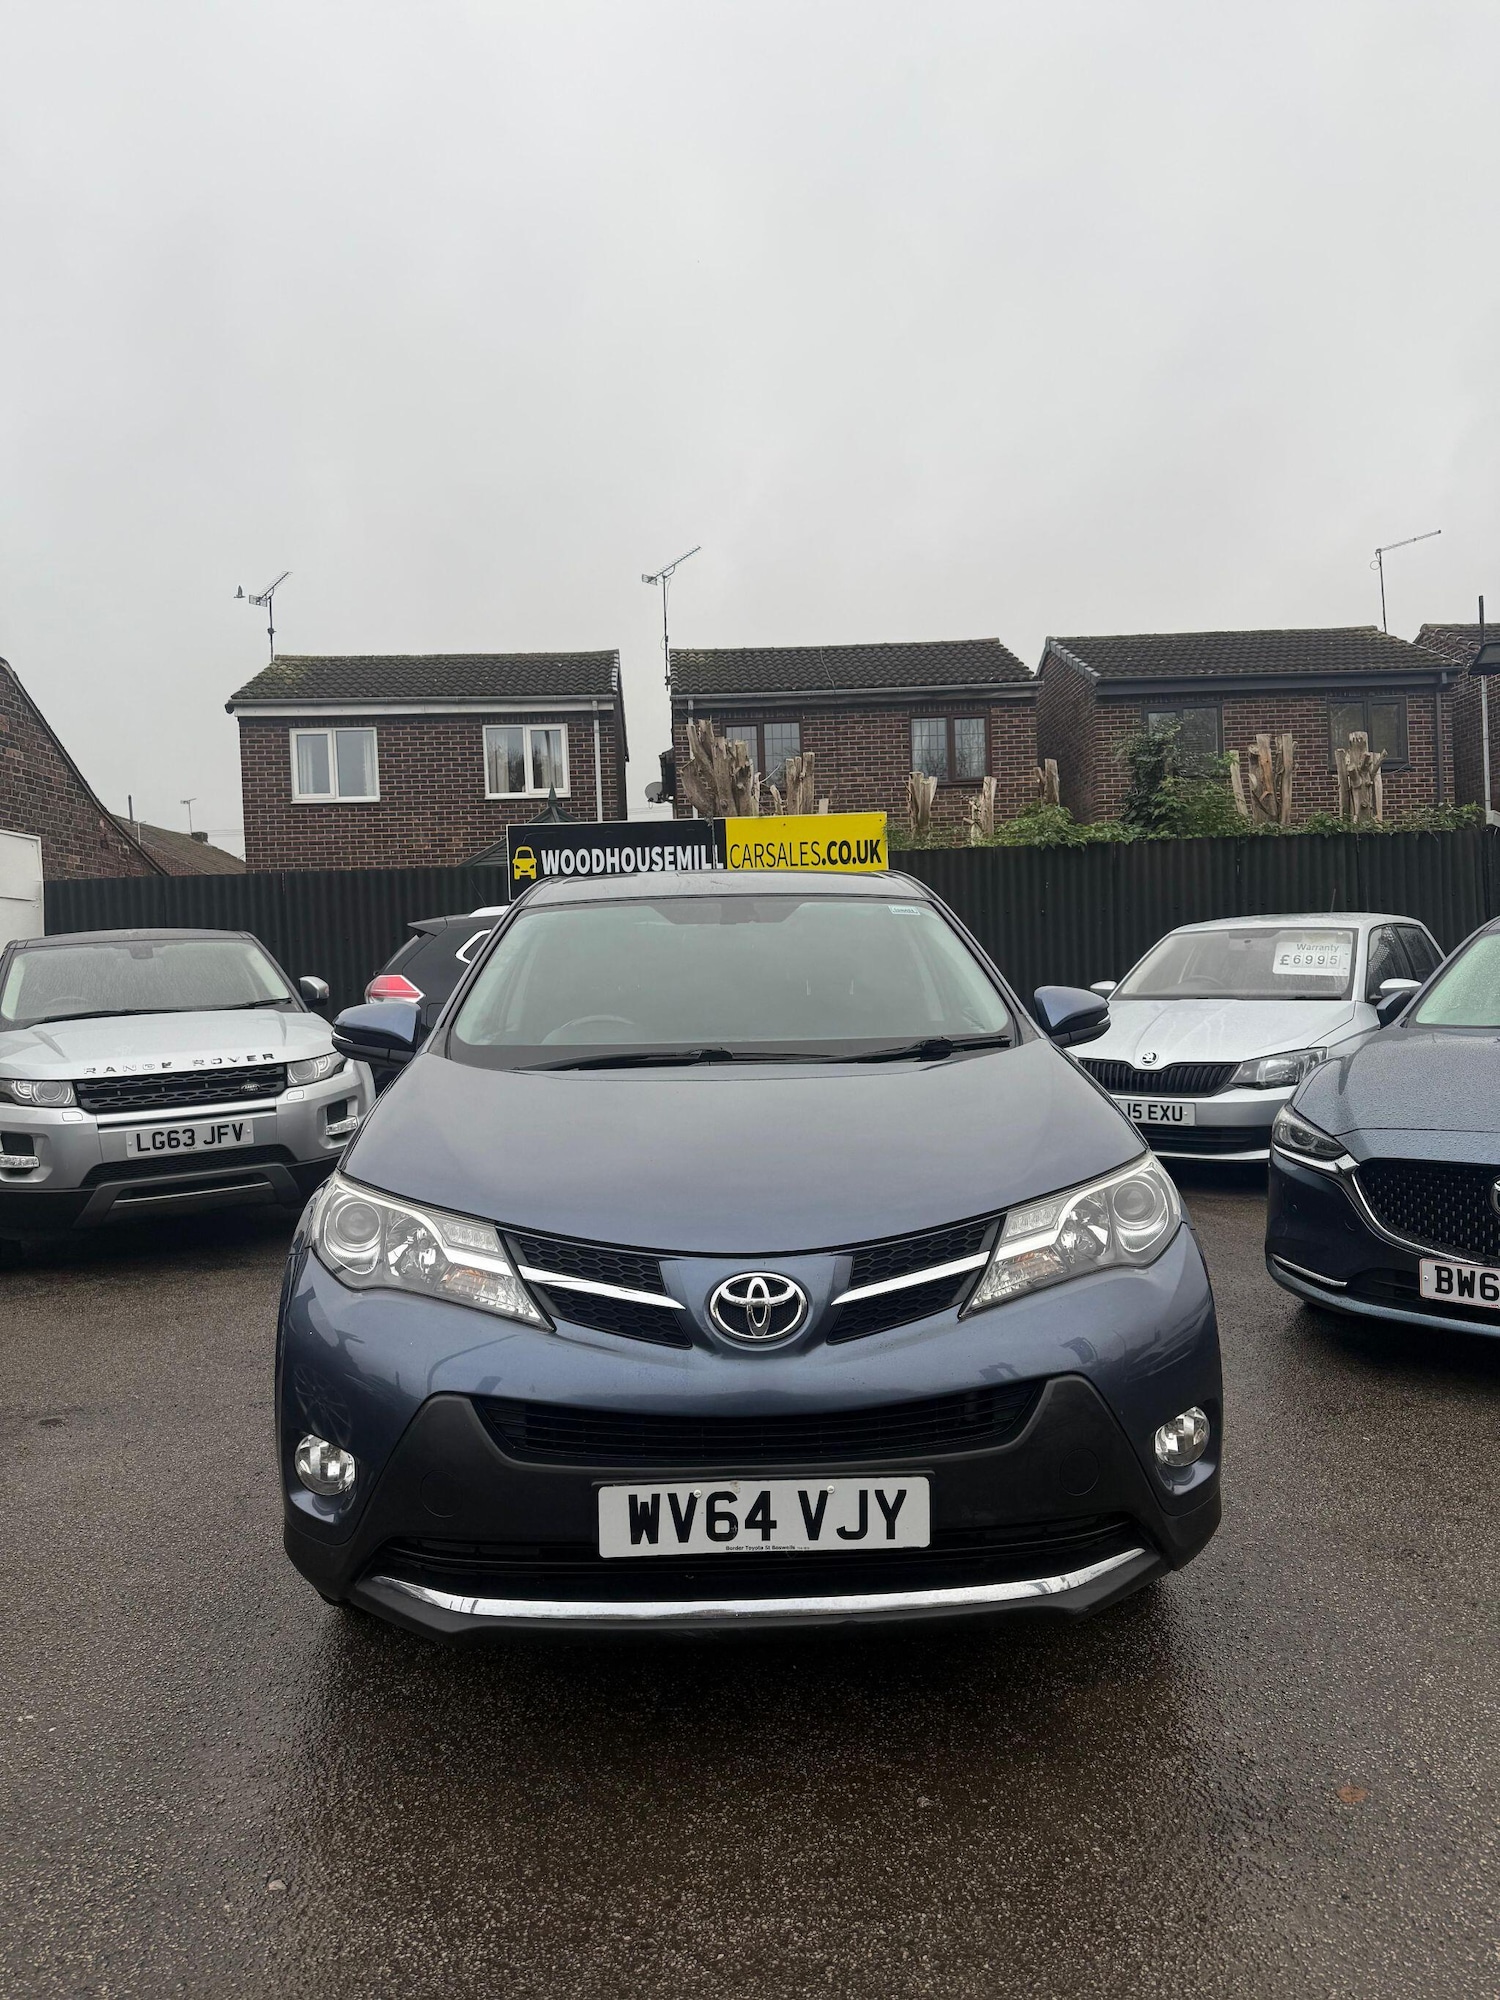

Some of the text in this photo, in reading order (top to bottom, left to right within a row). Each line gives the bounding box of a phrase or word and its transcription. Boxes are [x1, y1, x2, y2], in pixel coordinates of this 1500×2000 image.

[541, 839, 882, 875] WOODHOUSEMILL CARSALES.CO.UK
[1280, 954, 1338, 966] £6995
[1296, 943, 1339, 953] Warranty
[83, 1053, 275, 1075] RANGE ROVER
[1127, 1103, 1183, 1121] 15 EXU
[136, 1122, 244, 1152] LG63 JFV
[1434, 1265, 1500, 1302] BW6
[628, 1489, 907, 1545] WV64 VJY
